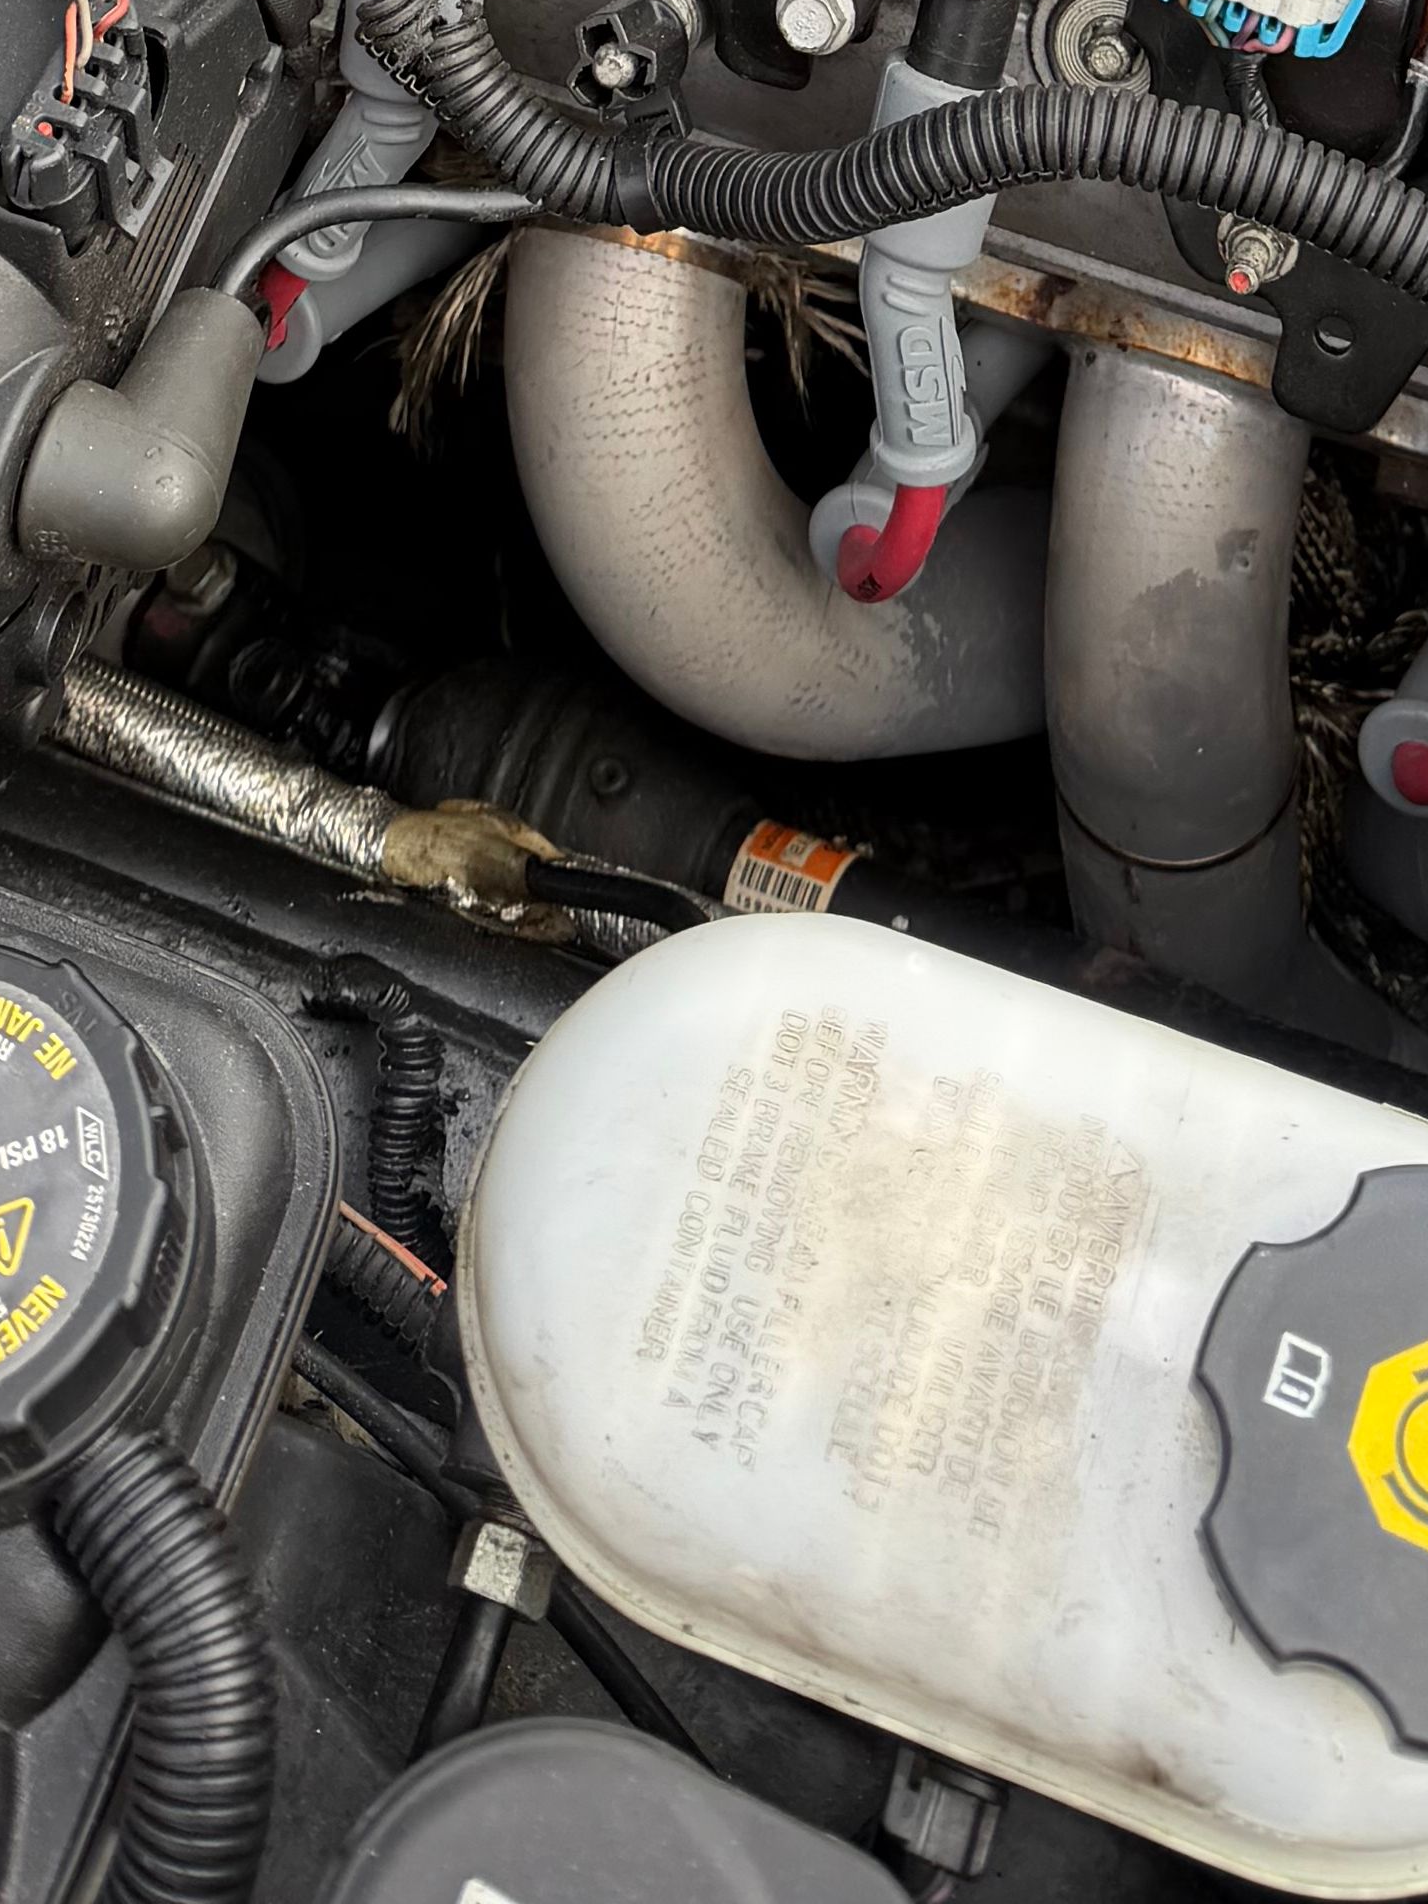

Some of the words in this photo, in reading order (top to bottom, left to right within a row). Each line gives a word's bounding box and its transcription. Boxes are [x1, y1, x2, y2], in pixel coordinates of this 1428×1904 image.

[896, 324, 951, 448] MSD
[32, 1031, 78, 1081] NE
[770, 1008, 812, 1072] DOT
[762, 1069, 790, 1094] 3
[38, 1124, 69, 1155] 18
[83, 1122, 102, 1164] WLC
[727, 1097, 782, 1198] BRAKE
[69, 1184, 107, 1263] 25730224
[720, 1293, 762, 1360] USE
